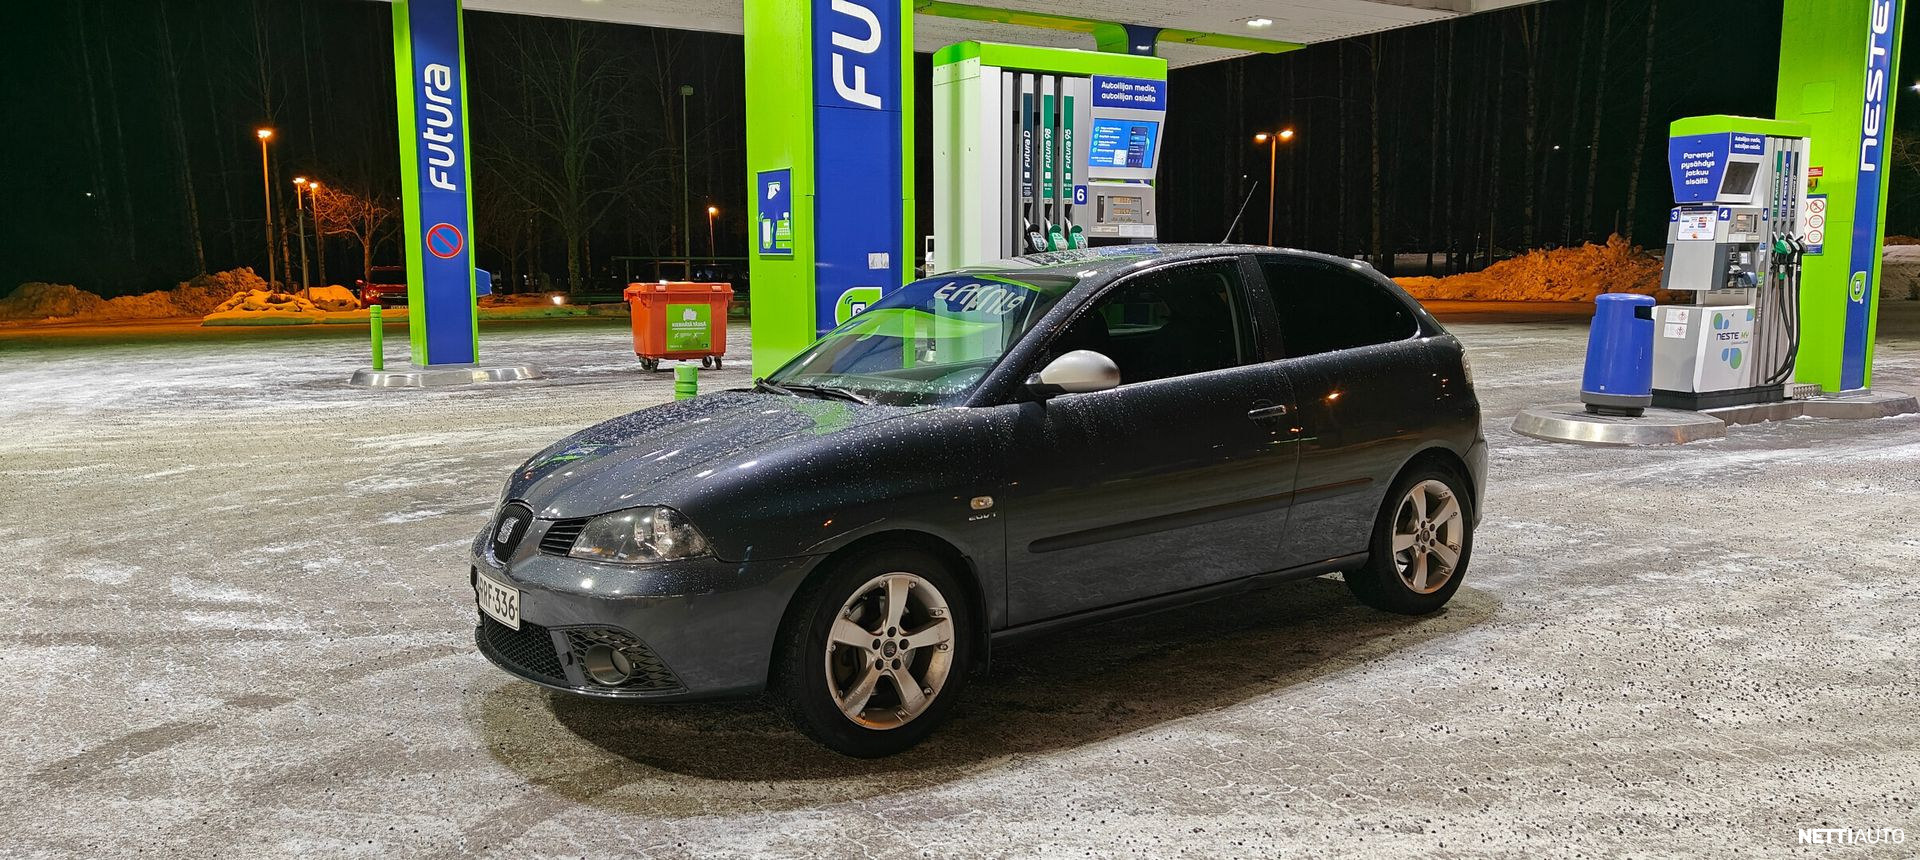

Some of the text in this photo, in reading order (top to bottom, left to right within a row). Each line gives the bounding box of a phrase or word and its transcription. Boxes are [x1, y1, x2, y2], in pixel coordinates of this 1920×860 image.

[1101, 81, 1134, 92] Autoilijan
[1860, 0, 1890, 172] NESTE
[1101, 92, 1134, 102] autoilijan
[423, 63, 456, 191] Futura
[1024, 130, 1031, 138] D
[1044, 140, 1052, 169] Futura
[1064, 141, 1072, 169] Futura
[1683, 151, 1714, 160] Parempi
[1685, 168, 1709, 177] jatkuu
[1076, 188, 1085, 201] 6
[1671, 211, 1678, 220] 3
[1720, 210, 1728, 219] 4
[1716, 331, 1740, 341] NESTE
